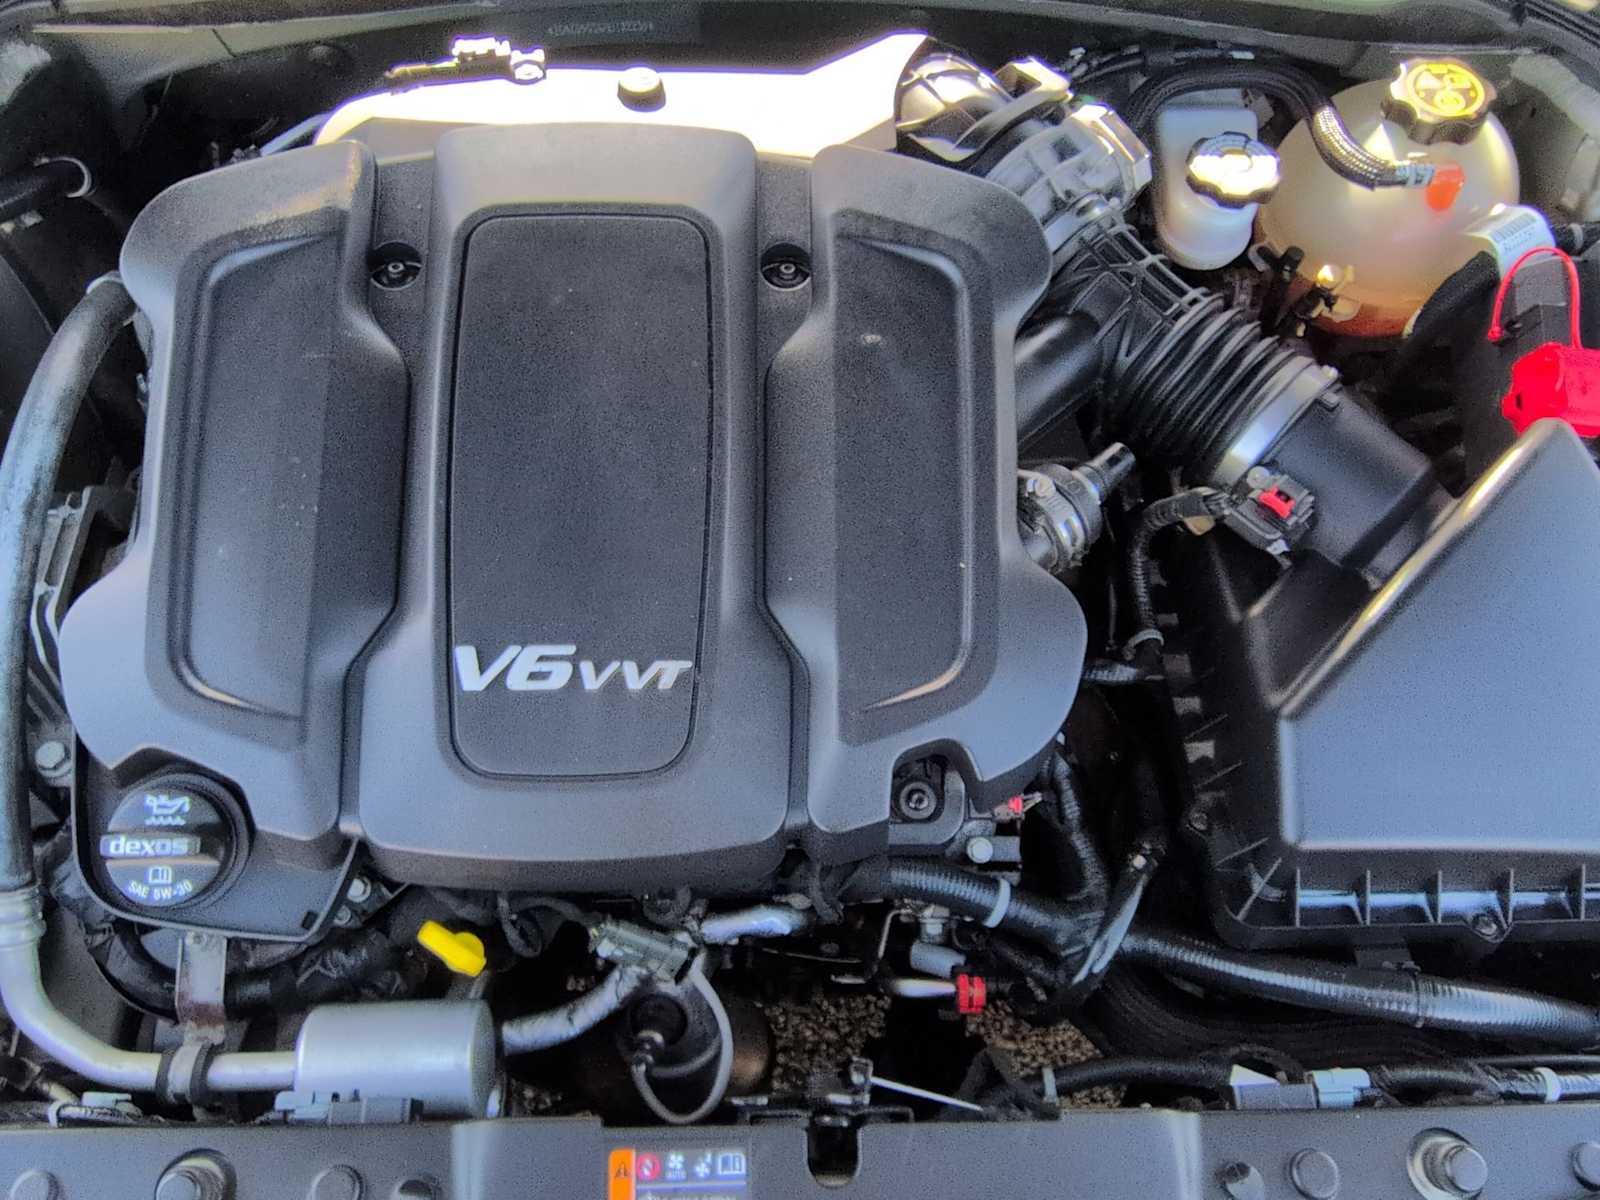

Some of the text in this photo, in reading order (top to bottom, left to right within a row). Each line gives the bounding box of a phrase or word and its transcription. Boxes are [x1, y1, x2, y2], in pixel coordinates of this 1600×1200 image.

[454, 644, 693, 692] V6 VVT
[109, 836, 188, 856] dexos
[128, 880, 151, 899] SAE
